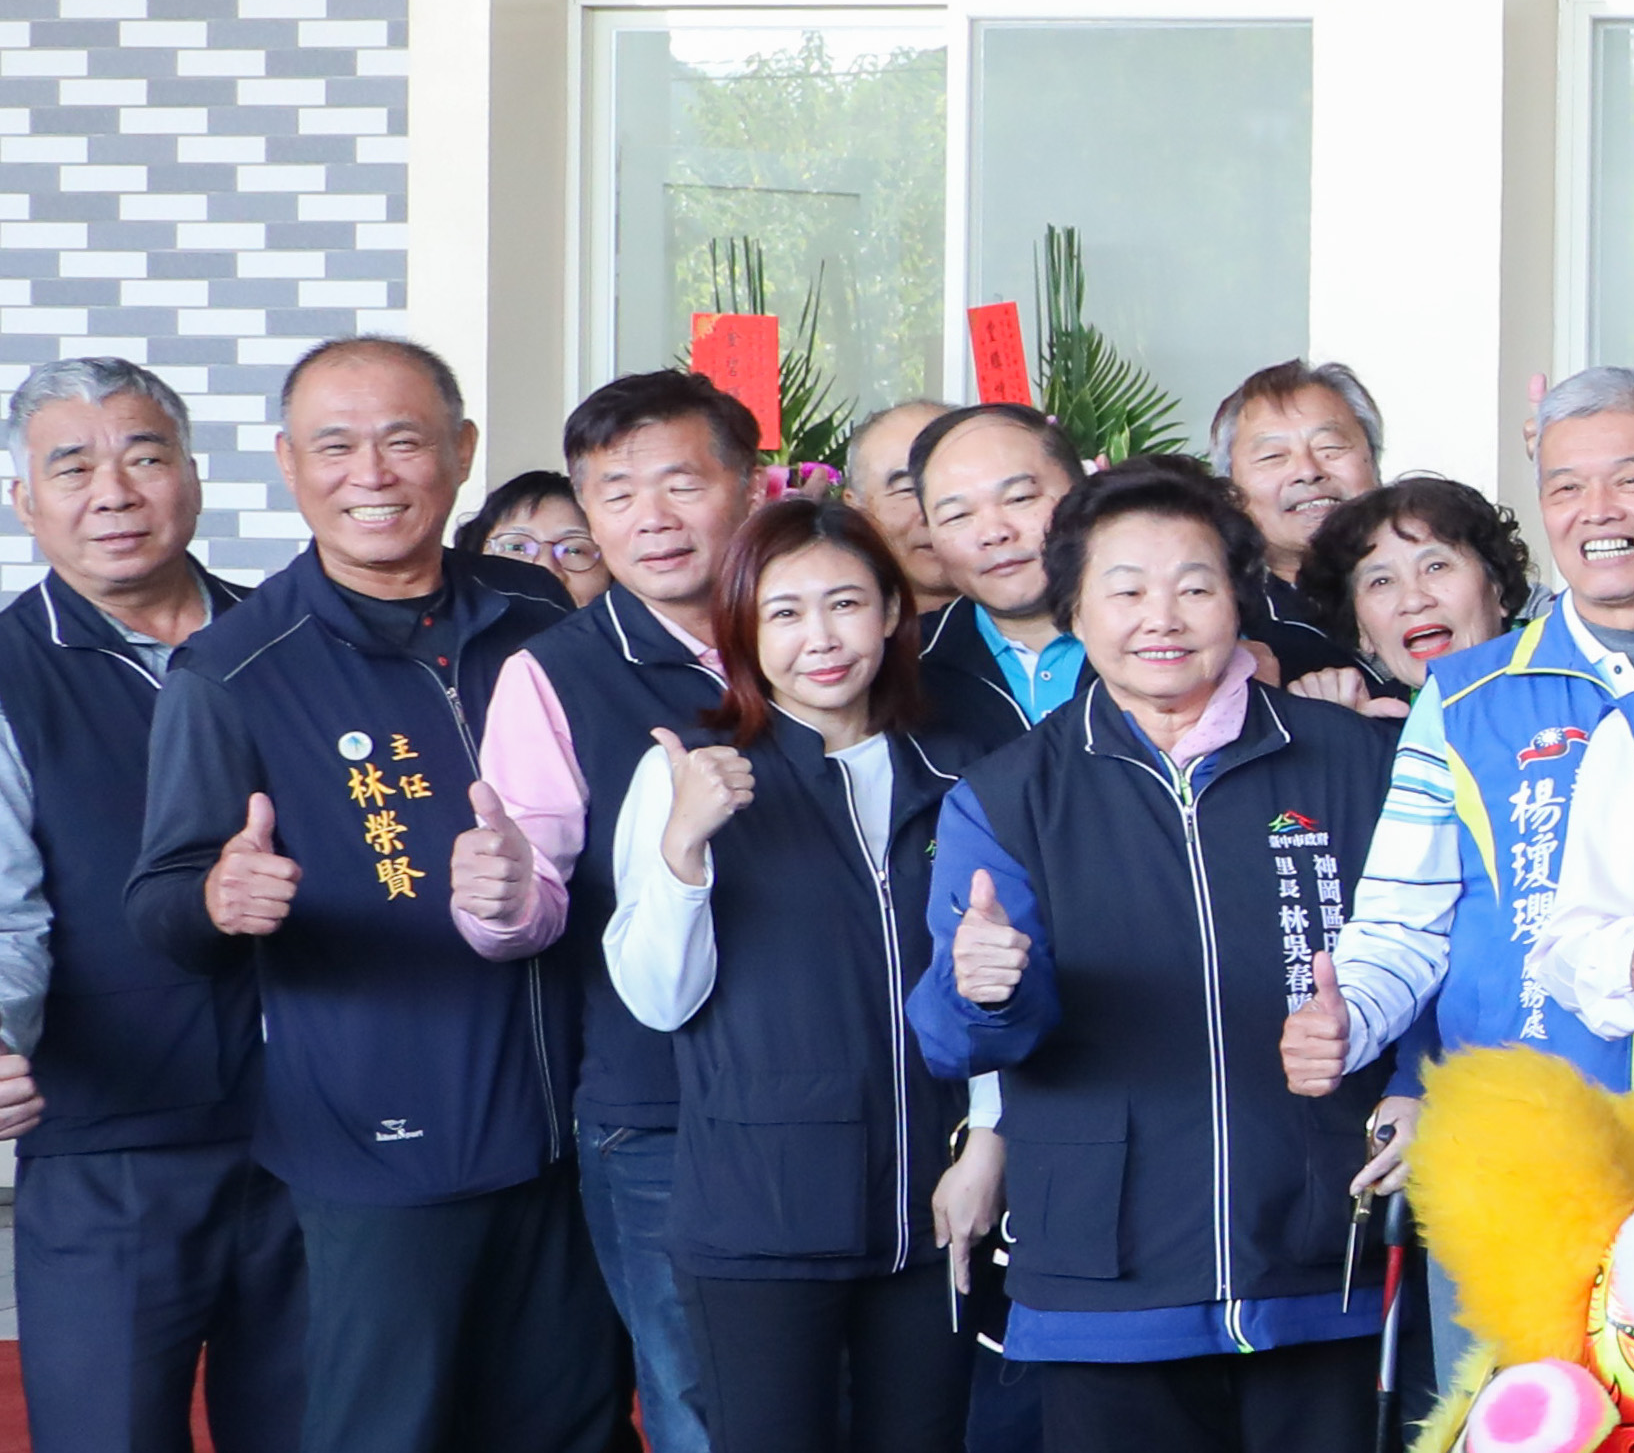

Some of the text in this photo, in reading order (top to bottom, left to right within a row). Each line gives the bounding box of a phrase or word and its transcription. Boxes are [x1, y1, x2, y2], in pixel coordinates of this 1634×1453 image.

[389, 733, 434, 800] 主任
[348, 762, 427, 902] 林榮賢
[1267, 831, 1331, 849] 臺中市政府
